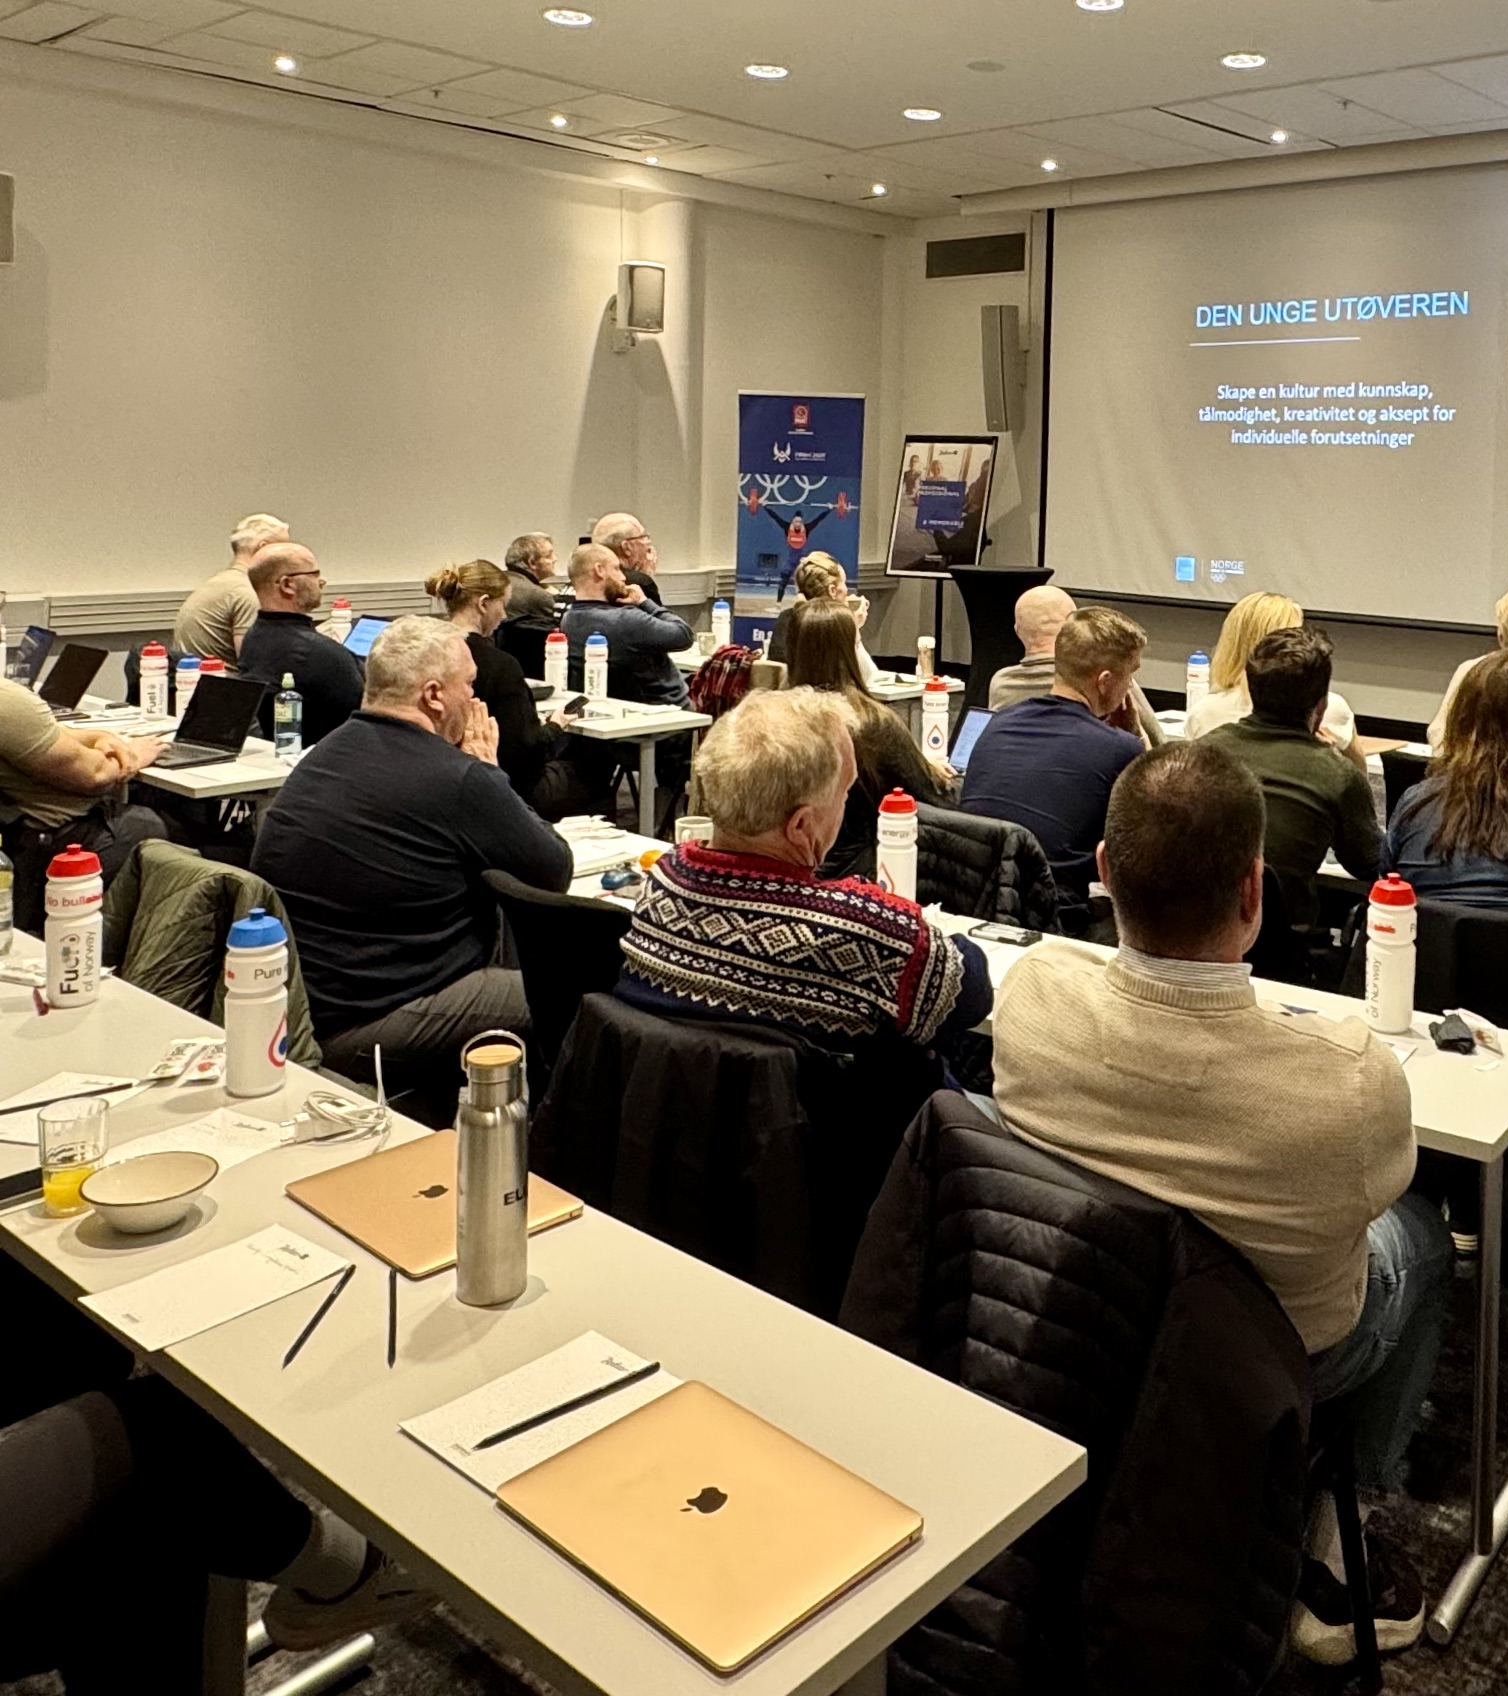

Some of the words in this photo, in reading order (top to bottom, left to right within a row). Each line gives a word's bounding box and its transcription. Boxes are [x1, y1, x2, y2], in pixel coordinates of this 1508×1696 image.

[1196, 303, 1243, 328] DEN
[1250, 300, 1318, 326] UNGE
[1324, 290, 1470, 322] UTØVEREN
[1217, 384, 1256, 402] Skape
[1259, 387, 1276, 399] en
[1279, 383, 1320, 399] kultur
[1323, 382, 1355, 398] med
[1359, 381, 1433, 401] kunnskap,
[1198, 406, 1281, 425] tålmodighet,
[1284, 405, 1356, 421] kreativitet
[1358, 409, 1378, 425] og
[1380, 405, 1430, 425] aksept
[1433, 404, 1457, 421] for
[1231, 428, 1308, 444] individuelle
[1310, 428, 1415, 449] forutsetninger
[1210, 559, 1245, 571] NORGE
[253, 966, 283, 981] Pure
